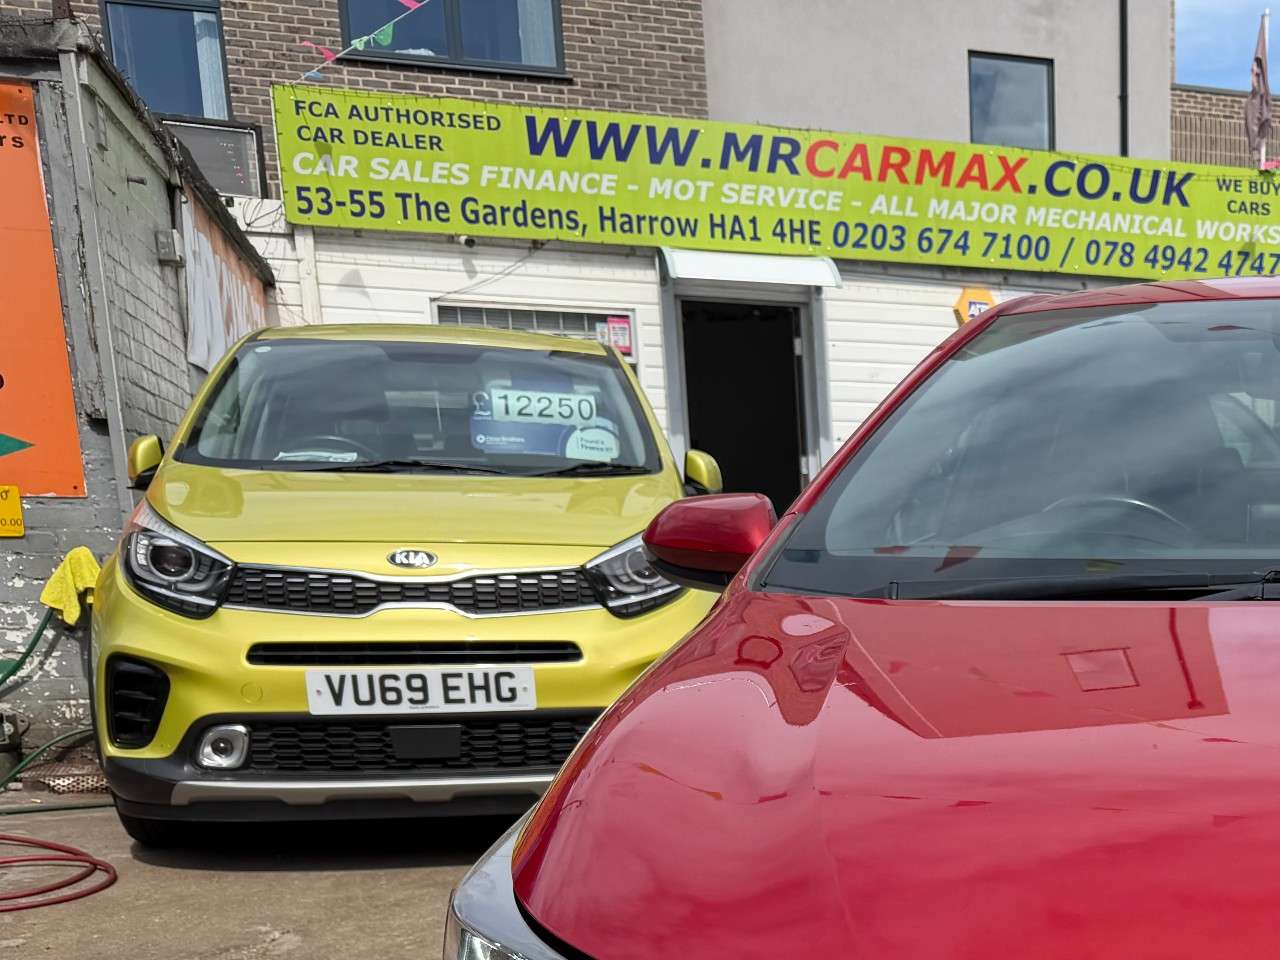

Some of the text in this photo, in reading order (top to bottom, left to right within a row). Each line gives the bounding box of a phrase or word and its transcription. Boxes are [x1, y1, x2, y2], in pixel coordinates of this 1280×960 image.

[0, 113, 29, 125] TD
[294, 100, 501, 132] FCA AUTHORISED
[297, 125, 444, 151] CAR DEALER
[525, 115, 1196, 208] WWW.MRCARMAX.CO.UK
[293, 152, 359, 178] CAR
[369, 157, 470, 185] SALES
[480, 164, 618, 196] FINANCE
[648, 177, 713, 202] MOT
[720, 183, 843, 212] SERVICE
[870, 194, 918, 217] ALL
[927, 199, 1016, 225] MAJOR
[1025, 206, 1187, 238] MECHANICAL
[1216, 176, 1242, 193] WE
[1227, 200, 1271, 216] CARS
[296, 186, 385, 219] 53-55
[395, 192, 450, 223] The
[461, 197, 588, 237] Gardens,
[599, 205, 698, 238] Harrow
[709, 212, 761, 241] HA1
[772, 218, 822, 245] 4HE
[832, 221, 906, 252] 0203
[917, 227, 970, 256] 674
[982, 232, 1050, 262] 7100
[1060, 237, 1075, 268] /
[1085, 239, 1135, 268] 078
[1144, 245, 1208, 273] 4942
[497, 393, 594, 421] 12250
[395, 551, 431, 567] KIA
[324, 671, 518, 706] VU69 EHG
